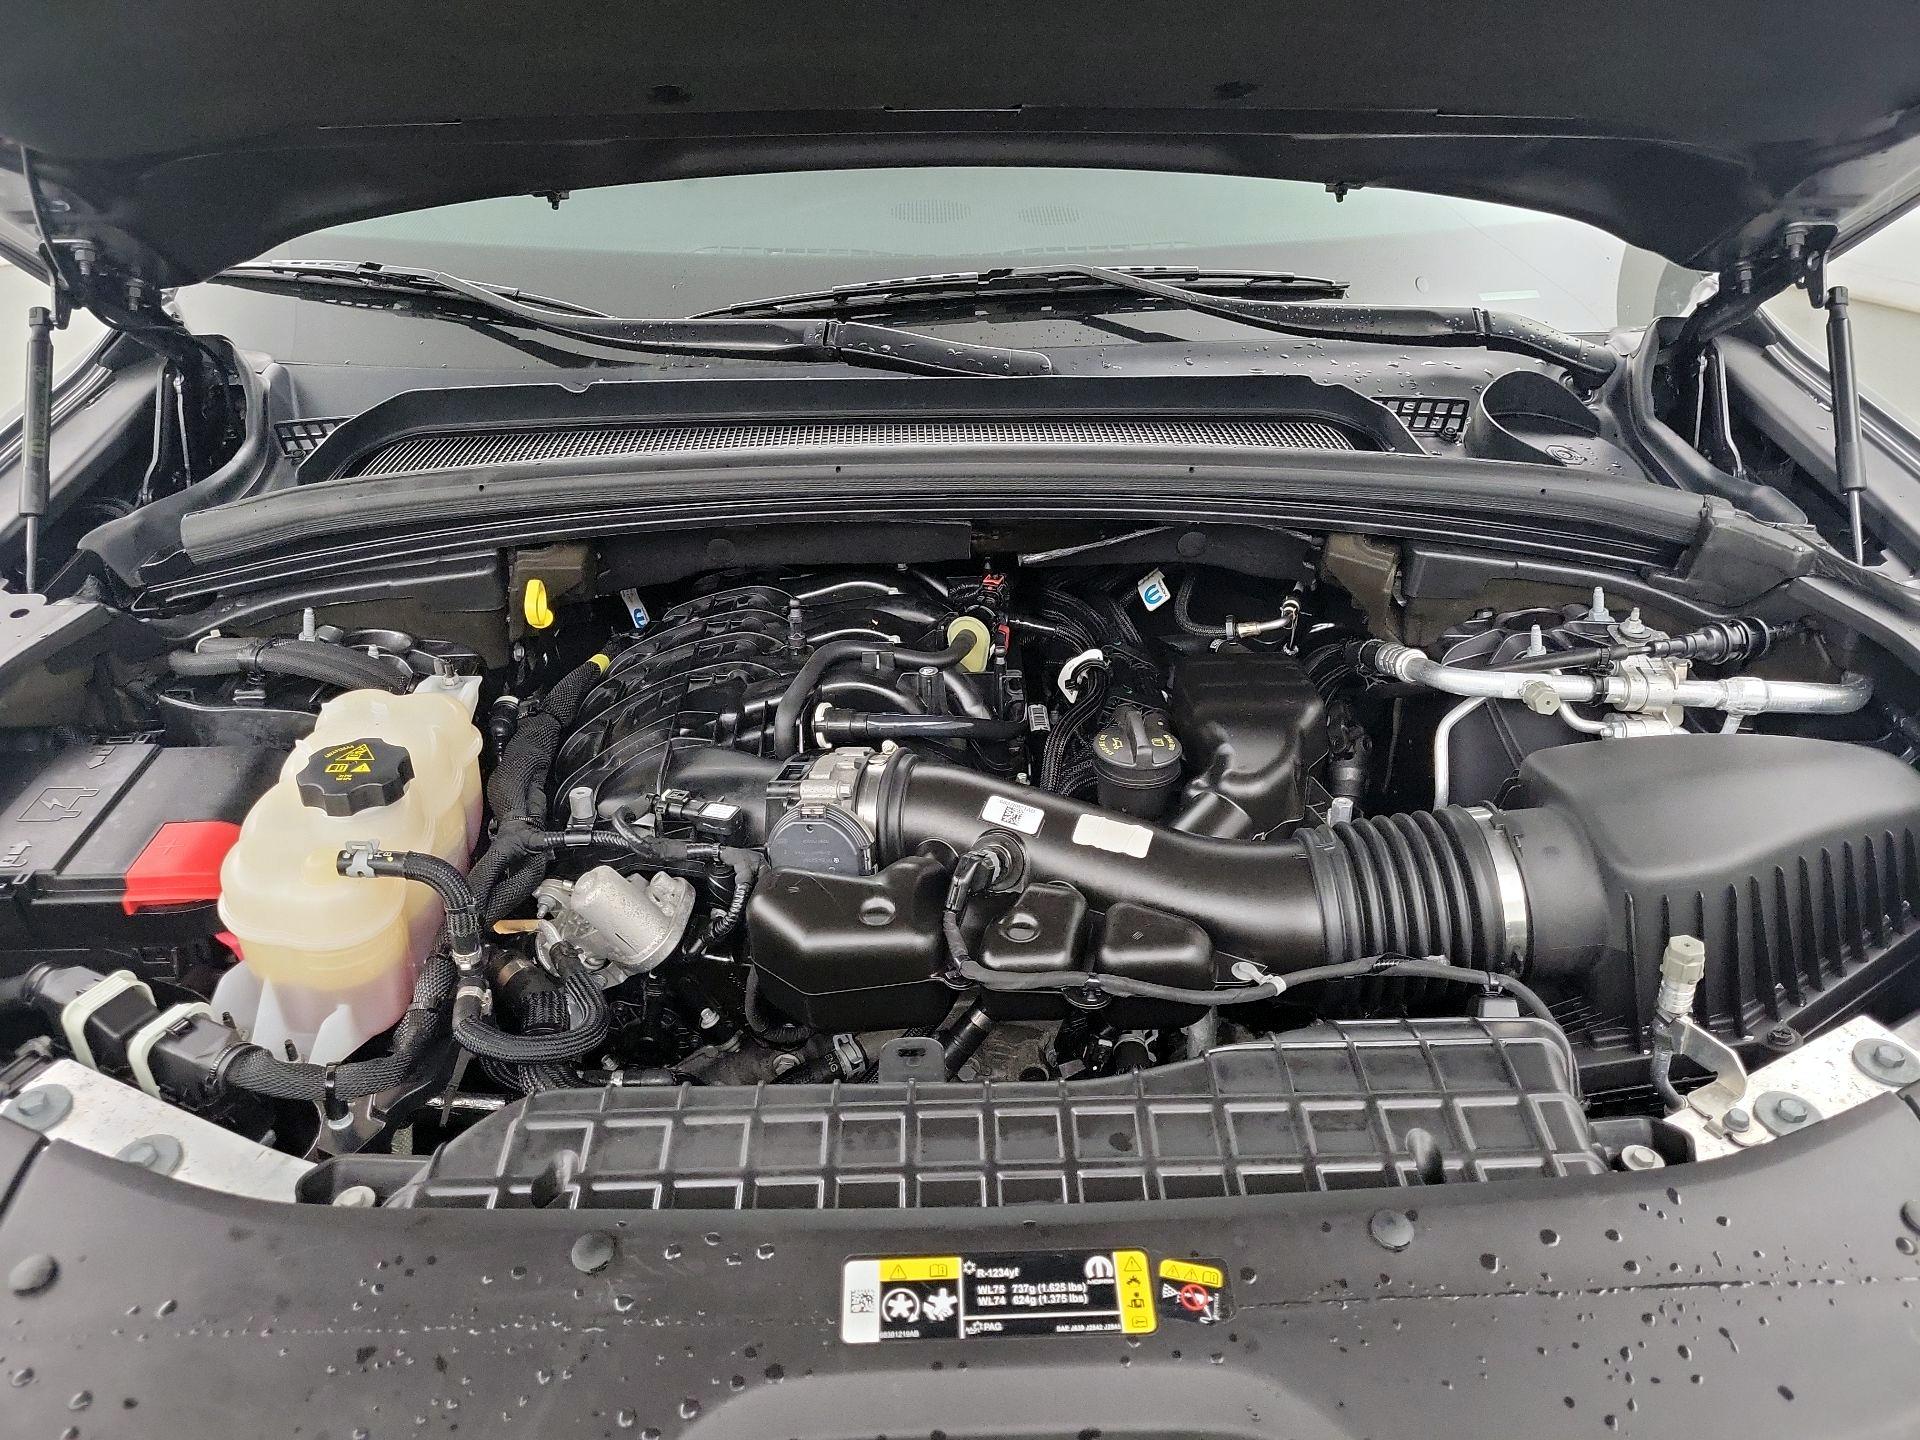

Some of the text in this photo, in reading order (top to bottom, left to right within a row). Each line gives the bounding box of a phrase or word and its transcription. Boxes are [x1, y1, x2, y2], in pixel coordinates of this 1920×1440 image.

[976, 1267, 1020, 1279] R-1234yf
[977, 1281, 1087, 1295] WL75 737g (1.625 lbs)
[977, 1293, 1089, 1306] WL74 624g (1.375 lbs)
[983, 1321, 1003, 1331] PAG
